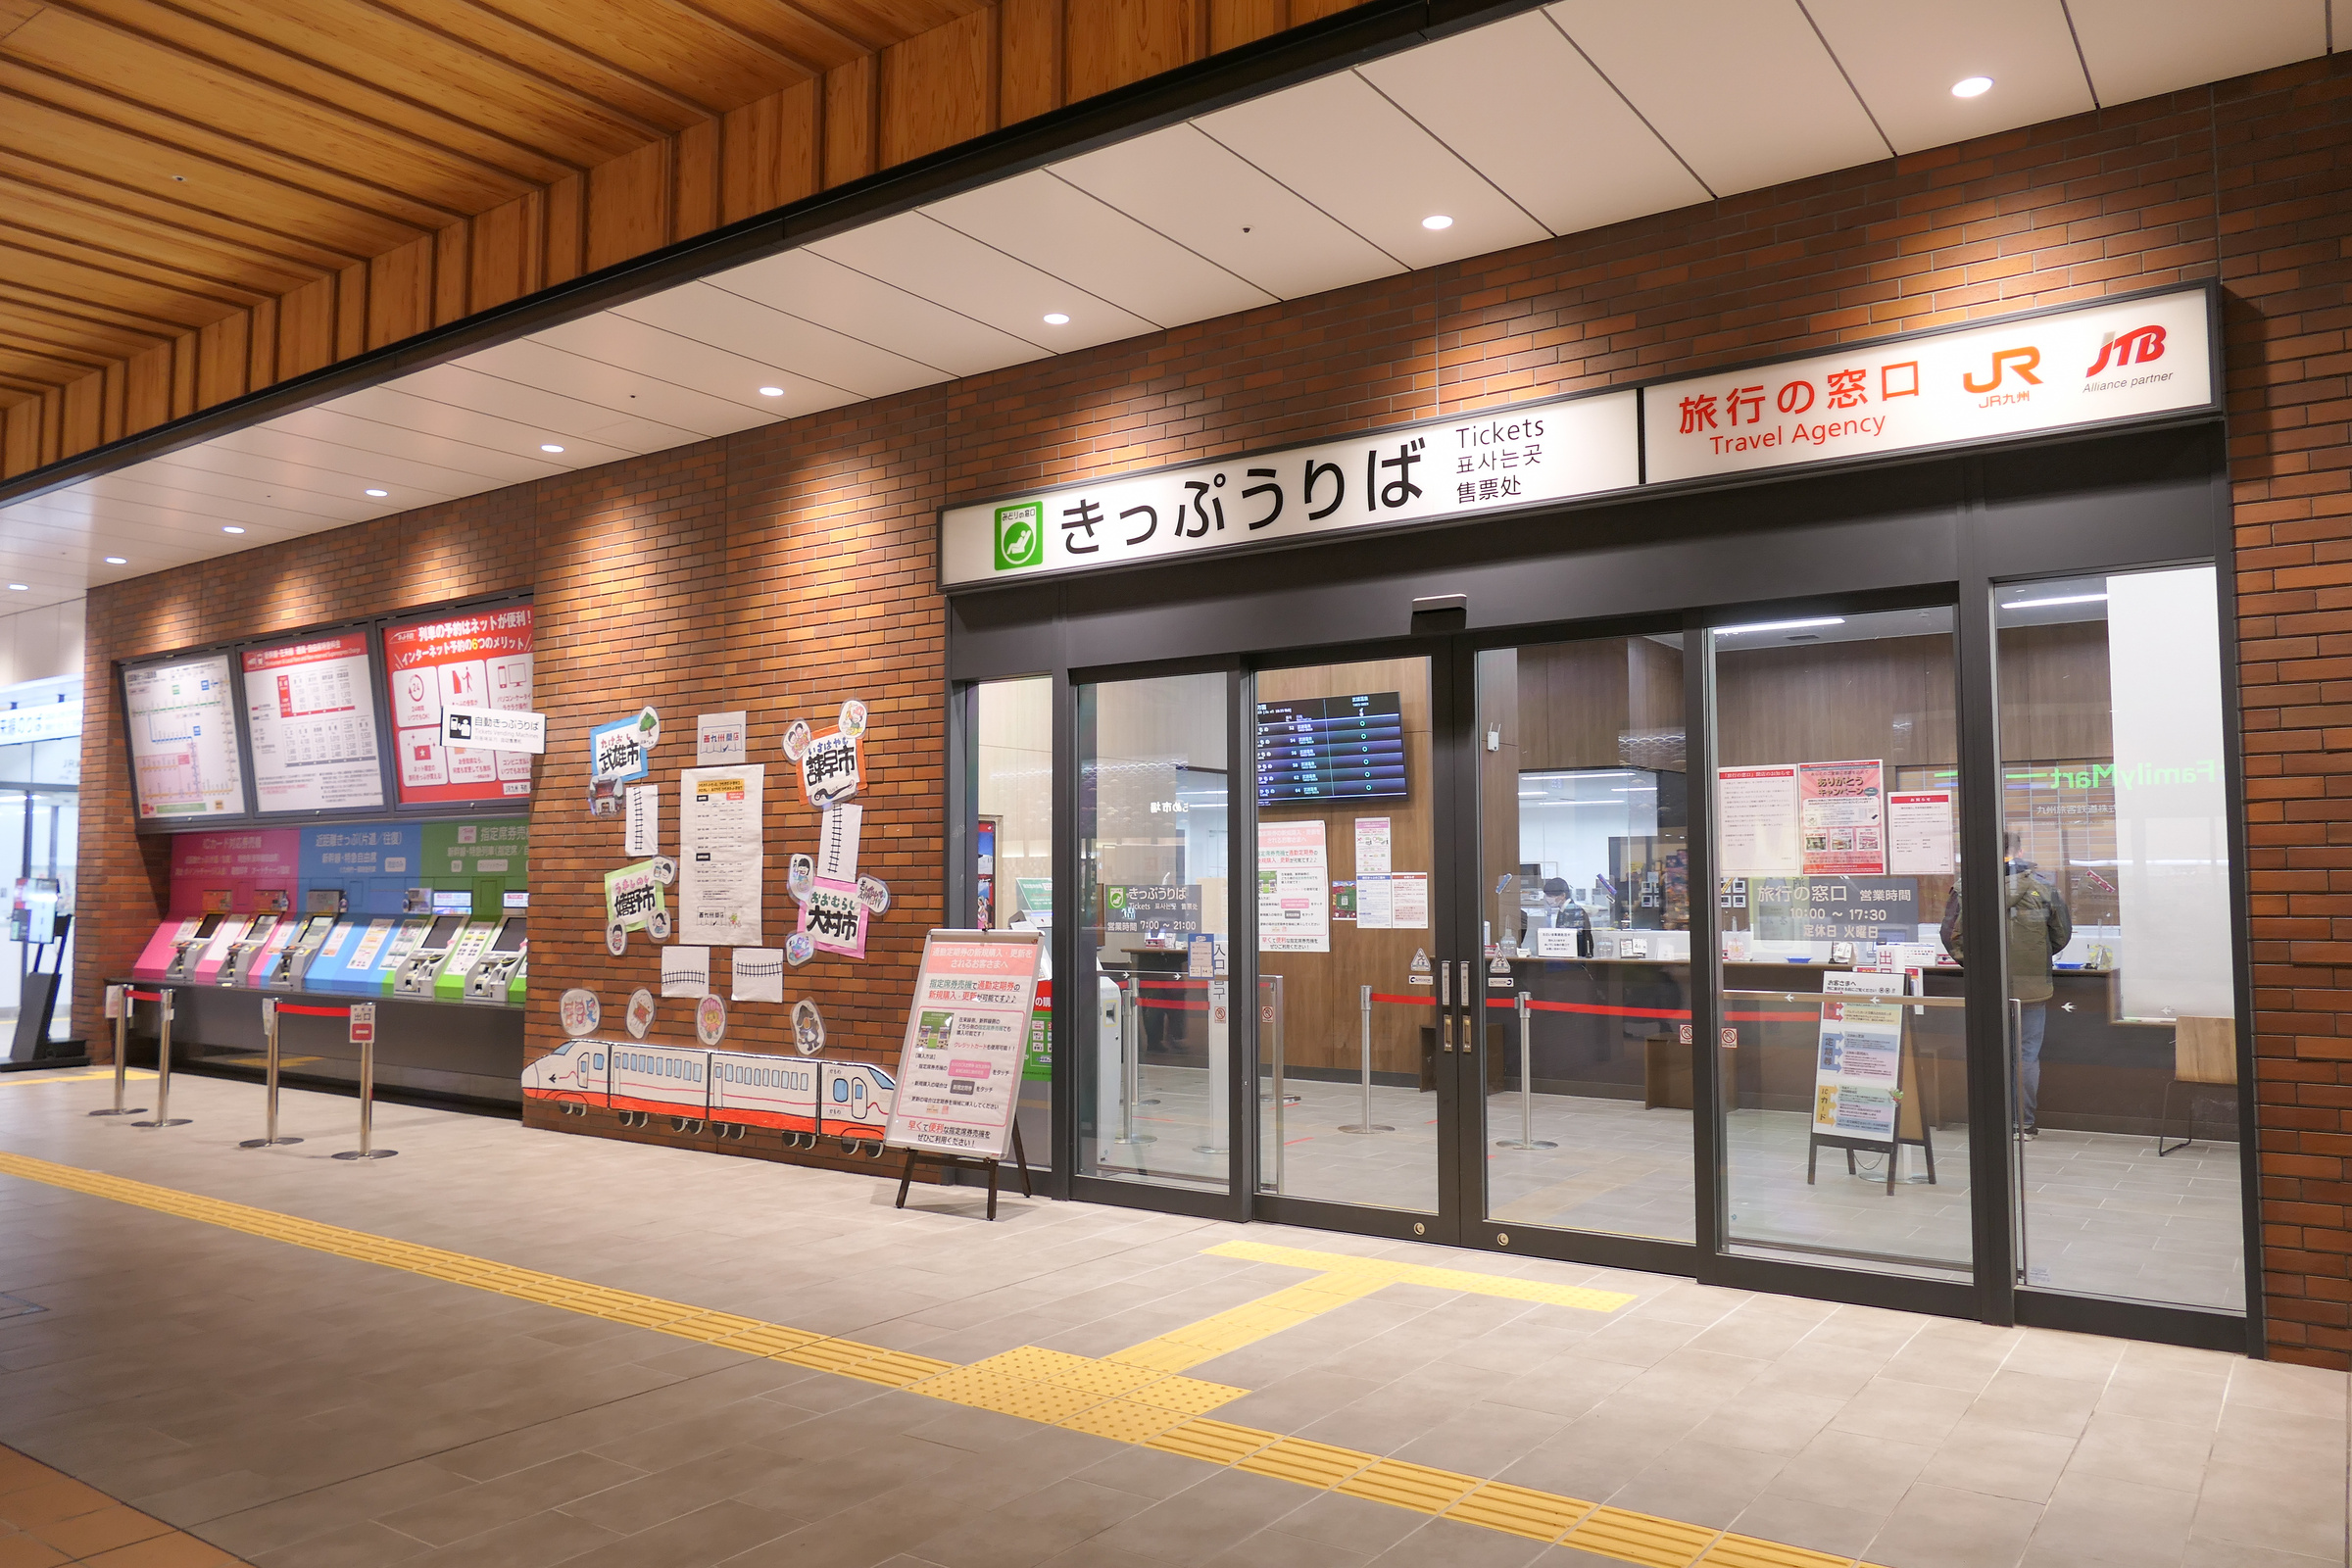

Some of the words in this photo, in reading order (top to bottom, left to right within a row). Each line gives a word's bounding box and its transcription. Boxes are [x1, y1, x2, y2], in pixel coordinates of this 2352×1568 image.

[2085, 324, 2168, 378] JTB
[1963, 346, 2044, 394] JR
[2082, 376, 2127, 394] Alliance
[2131, 369, 2174, 389] partner
[1679, 360, 1920, 435] 旅行の窓口
[1979, 389, 2032, 409] JR九州
[1455, 416, 1545, 450] Tickets
[1710, 425, 1783, 456] Travel
[1791, 415, 1886, 447] Agency
[1455, 443, 1544, 474] 표사는곳
[1060, 437, 1426, 556] きっぷうりば
[1455, 475, 1523, 505] 售票处
[1002, 508, 1036, 521] みどりの窓口
[402, 635, 525, 665] インターネット予約の6つのメリット
[413, 682, 420, 692] 24
[475, 716, 540, 731] 自動きっぷうりば
[601, 733, 630, 749] たけおし
[599, 739, 639, 775] 武雄市
[806, 745, 856, 786] 諫早市
[1818, 777, 1864, 788] ありがとう
[1819, 788, 1864, 797] キャンペーン
[480, 826, 529, 842] 指定席券売
[614, 884, 656, 919] 嬉野市
[810, 892, 856, 911] おおむらし
[1128, 886, 1187, 900] きっぷうりば
[1757, 885, 1847, 903] 旅行の窓口
[1860, 889, 1911, 902] 営業時間
[807, 905, 858, 941] 大村市
[1790, 907, 1826, 920] 10:00
[1849, 909, 1886, 921] 17:30
[1107, 922, 1138, 932] 営業時間
[1140, 920, 1159, 930] 7:00
[1173, 920, 1197, 930] 21:00
[1803, 925, 1837, 937] 定休日
[1844, 925, 1879, 938] 火曜日
[932, 947, 1033, 958] 通勤定期券の新規購入・更新を
[951, 959, 1008, 969] されるお客さまへ
[929, 978, 1021, 992] 指定席券売機で通勤定期券の
[907, 1120, 991, 1139] 早くて便利な指定席券売機を
